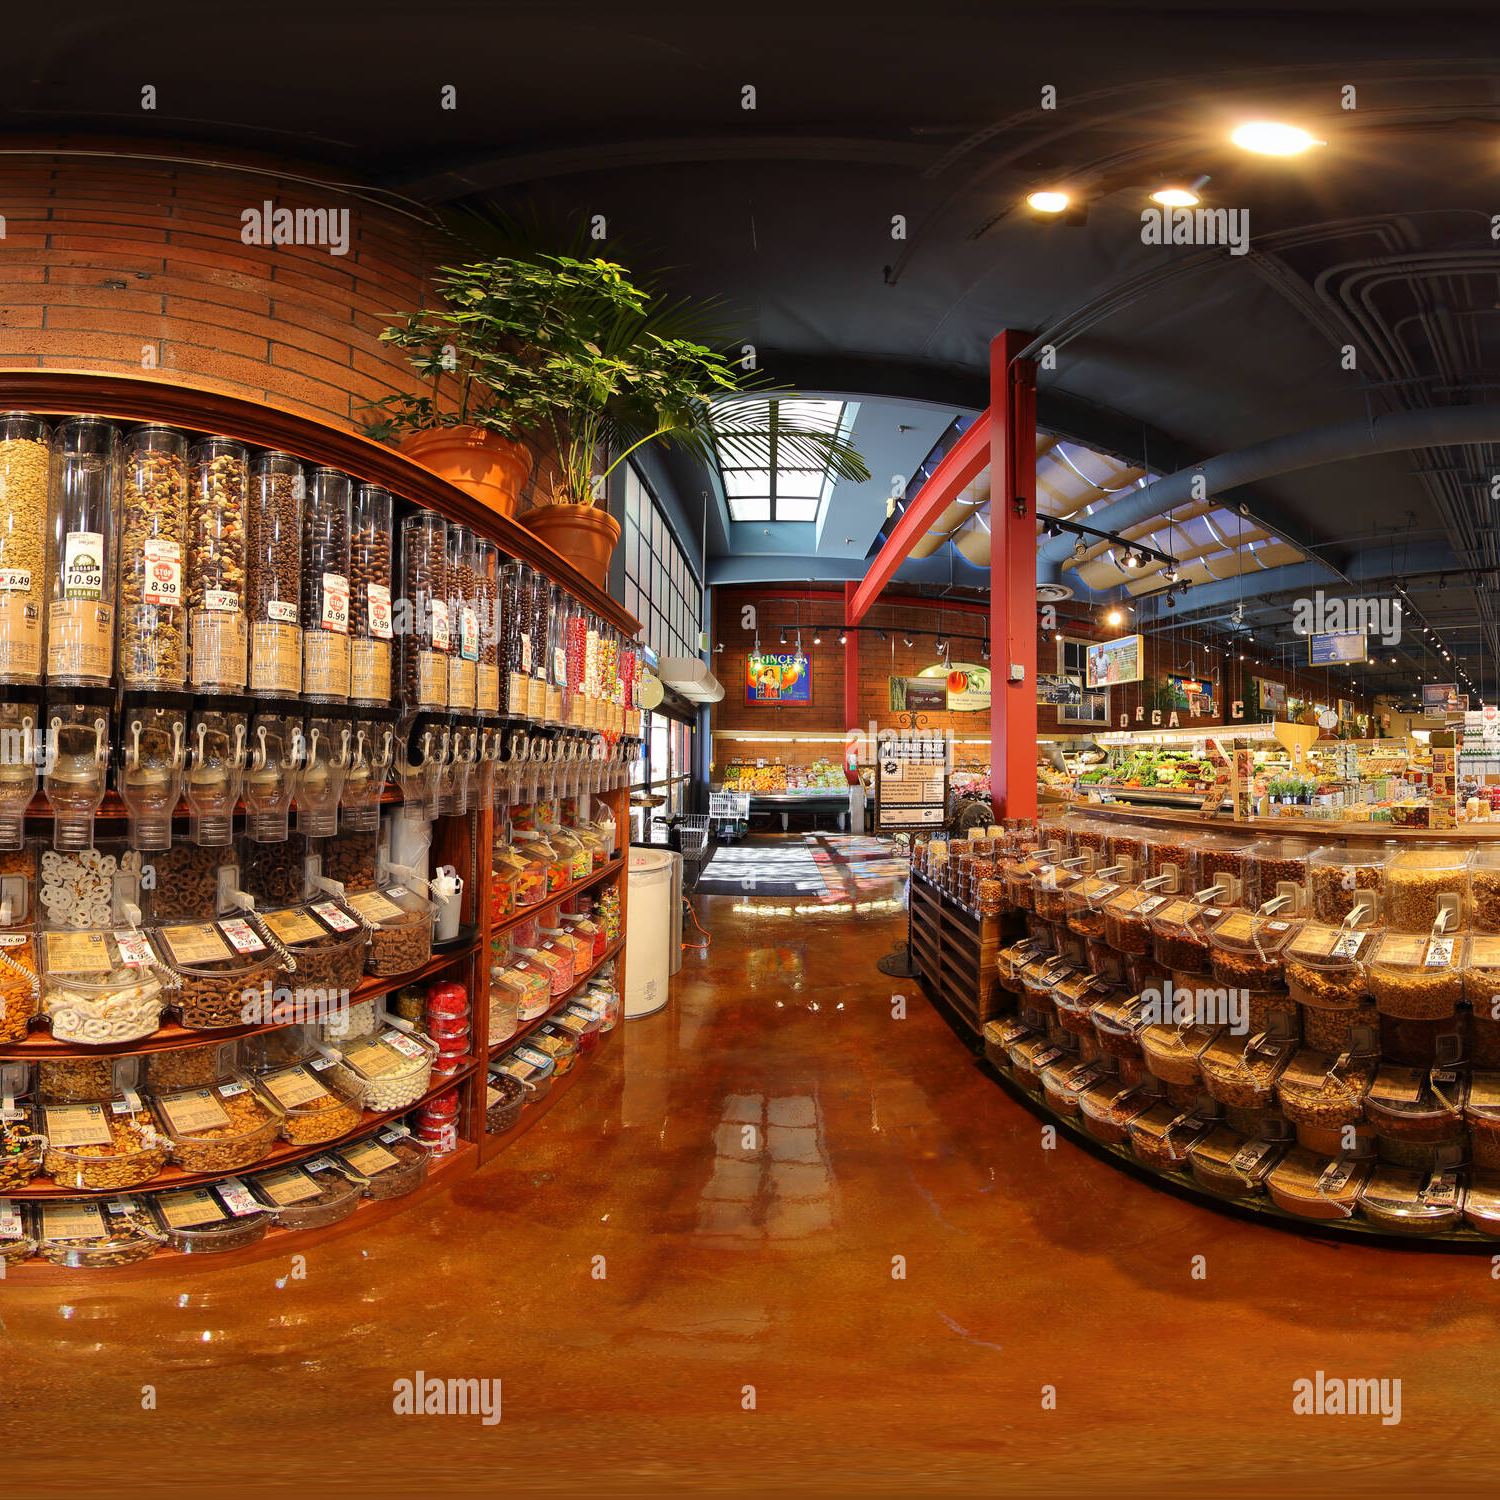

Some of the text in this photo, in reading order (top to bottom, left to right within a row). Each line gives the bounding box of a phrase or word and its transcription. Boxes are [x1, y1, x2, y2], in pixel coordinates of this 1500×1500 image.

[155, 568, 173, 577] STOP
[9, 575, 30, 586] 6.49
[67, 574, 101, 586] 10.99
[151, 581, 176, 593] 8.99
[221, 597, 238, 607] 7.99
[282, 608, 296, 618] 7.99
[327, 610, 345, 621] 8.99
[372, 619, 389, 629] 6.99
[750, 655, 808, 667] PRINCEA
